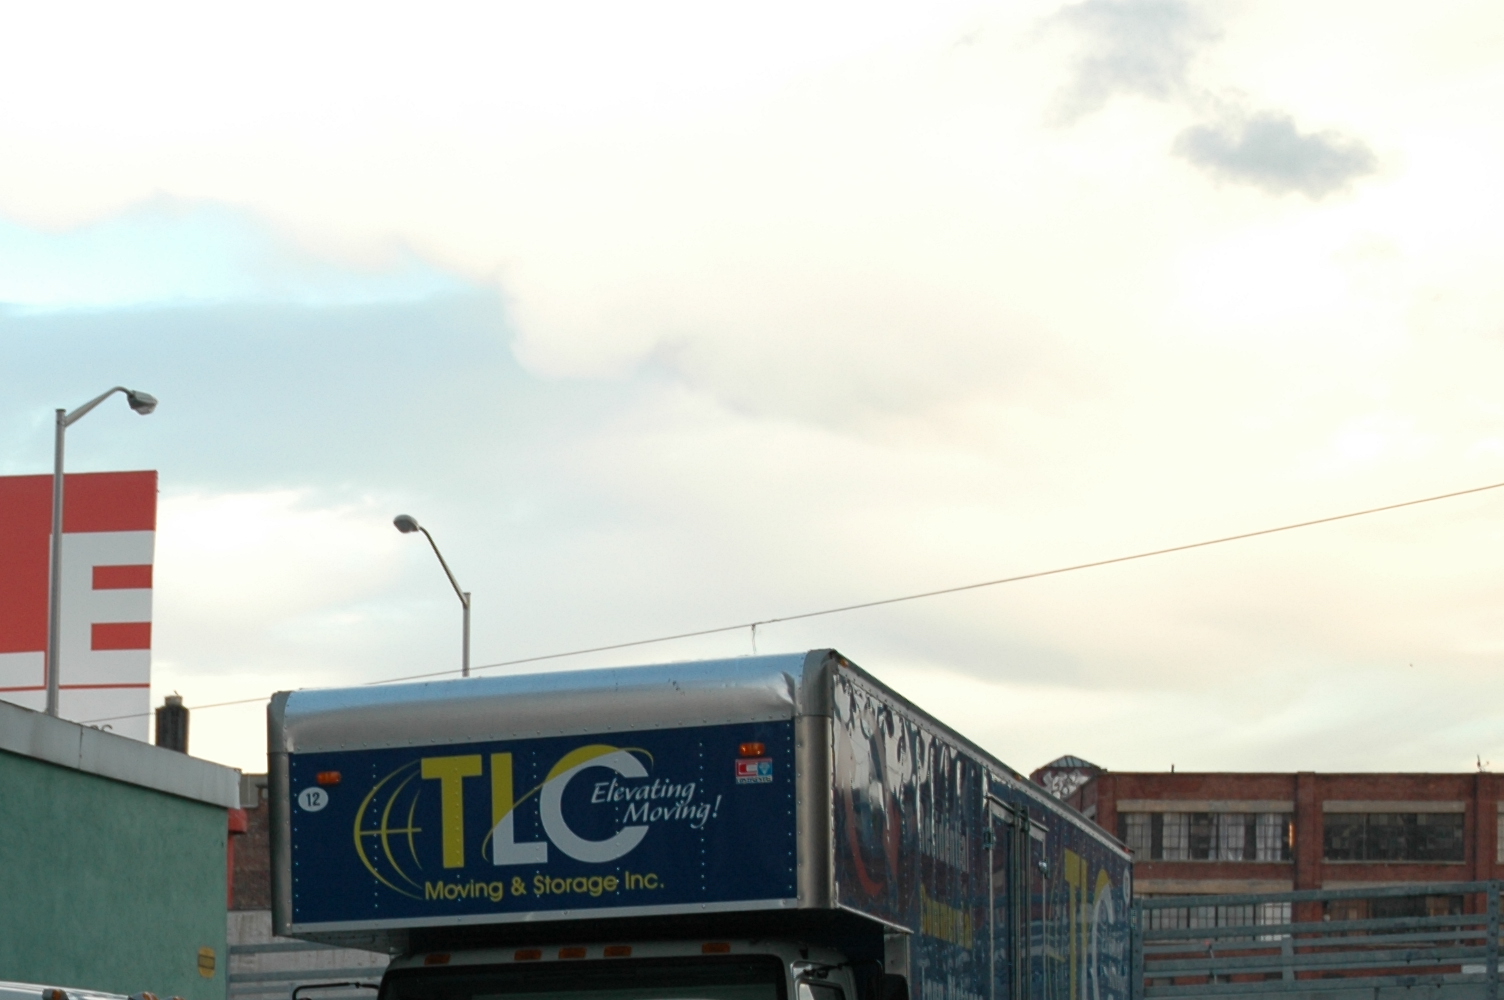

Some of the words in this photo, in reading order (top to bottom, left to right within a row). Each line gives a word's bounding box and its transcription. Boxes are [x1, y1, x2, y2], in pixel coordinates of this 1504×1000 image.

[306, 792, 321, 808] 12
[421, 744, 649, 869] TLC
[590, 777, 697, 805] Elevating
[622, 794, 722, 830] Moving!
[425, 879, 504, 901] Moving
[511, 876, 527, 897] &
[533, 873, 619, 896] Storage
[625, 870, 665, 890] Inc.
